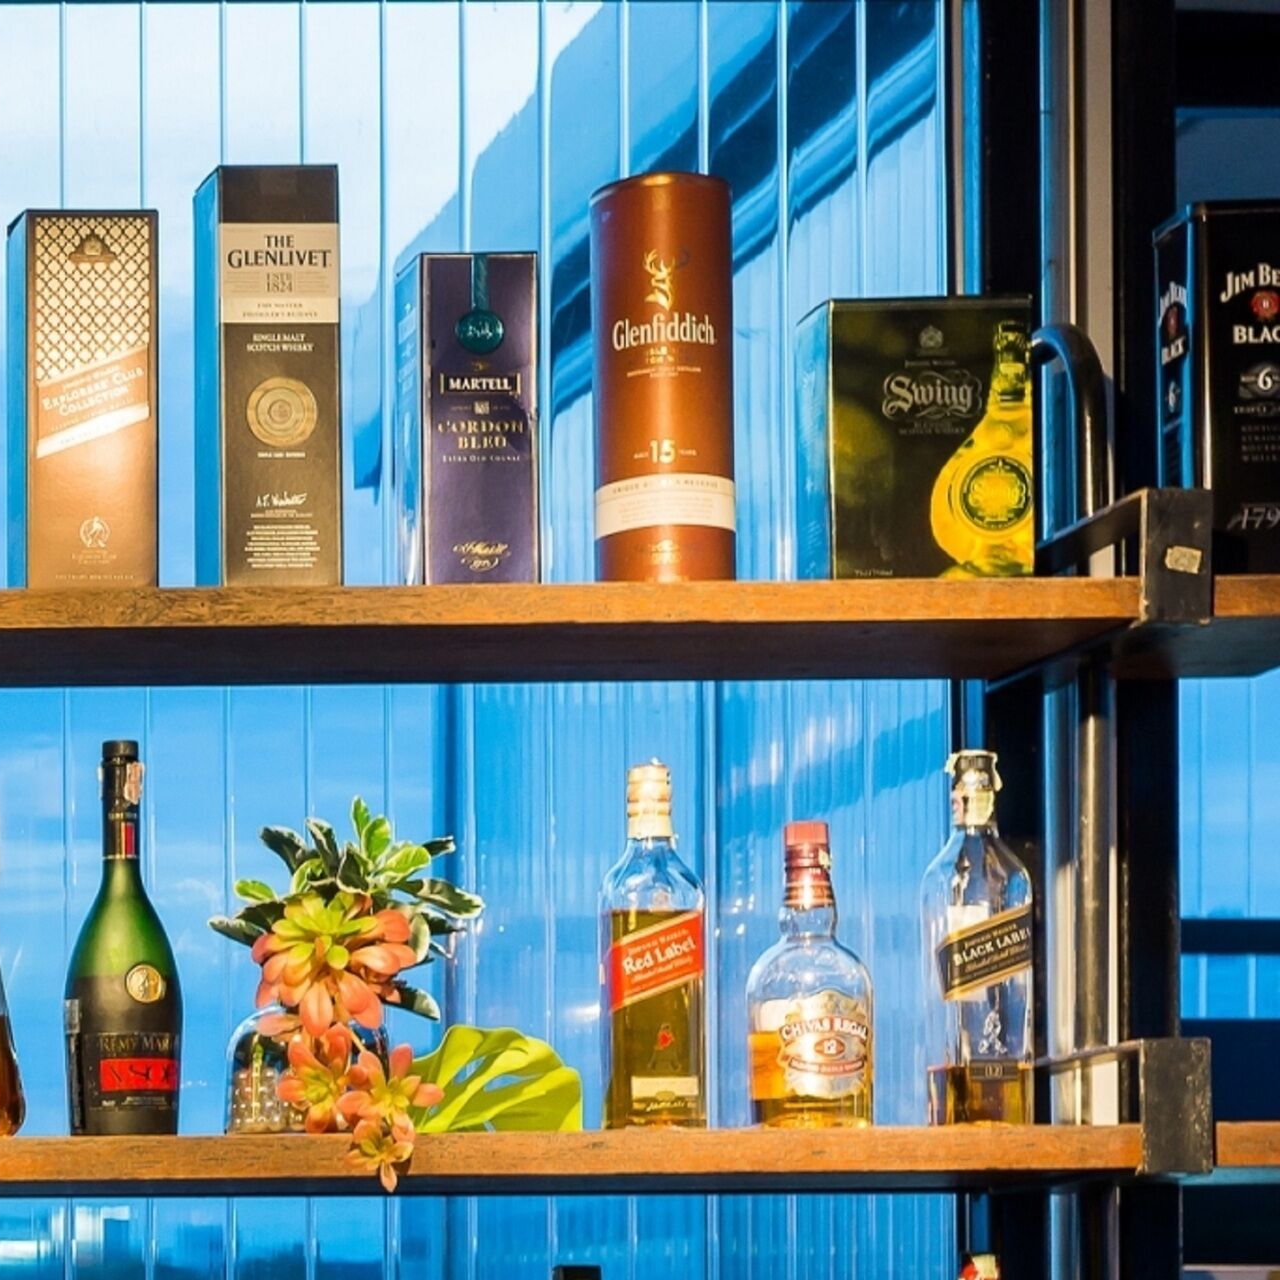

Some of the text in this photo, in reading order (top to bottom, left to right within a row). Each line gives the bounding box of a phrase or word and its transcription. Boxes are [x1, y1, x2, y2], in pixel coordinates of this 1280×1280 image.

[264, 235, 294, 249] THE
[227, 249, 330, 269] GLENLIVET
[266, 281, 293, 293] 1824
[1219, 269, 1256, 303] JIM
[282, 332, 306, 342] MALT
[612, 312, 716, 351] Glenfiddich
[448, 377, 512, 391] MARTELL
[1257, 367, 1272, 391] 6
[883, 375, 974, 418] Swing
[437, 420, 524, 434] CORDON
[650, 439, 676, 464] 15
[623, 936, 697, 978] Red Label
[953, 943, 994, 966] BLACK
[781, 1017, 830, 1040] CHIVAS
